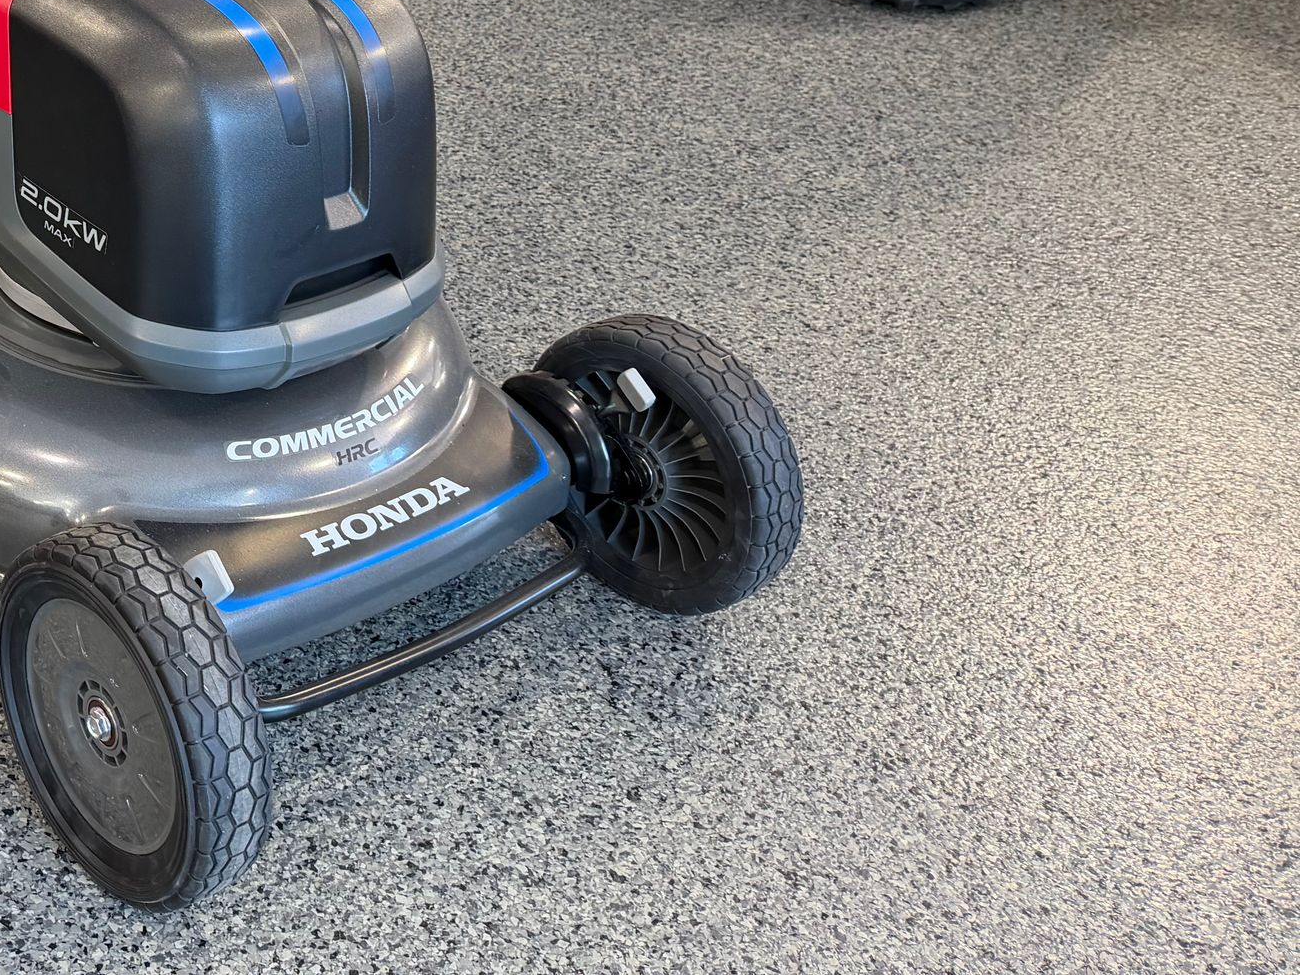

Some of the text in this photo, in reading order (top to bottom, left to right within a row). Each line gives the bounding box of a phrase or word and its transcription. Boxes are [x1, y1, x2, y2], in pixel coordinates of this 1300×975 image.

[44, 220, 72, 247] MAX
[226, 377, 425, 461] COMMERCIAL
[336, 437, 380, 466] HRC
[300, 476, 470, 557] HONDA
